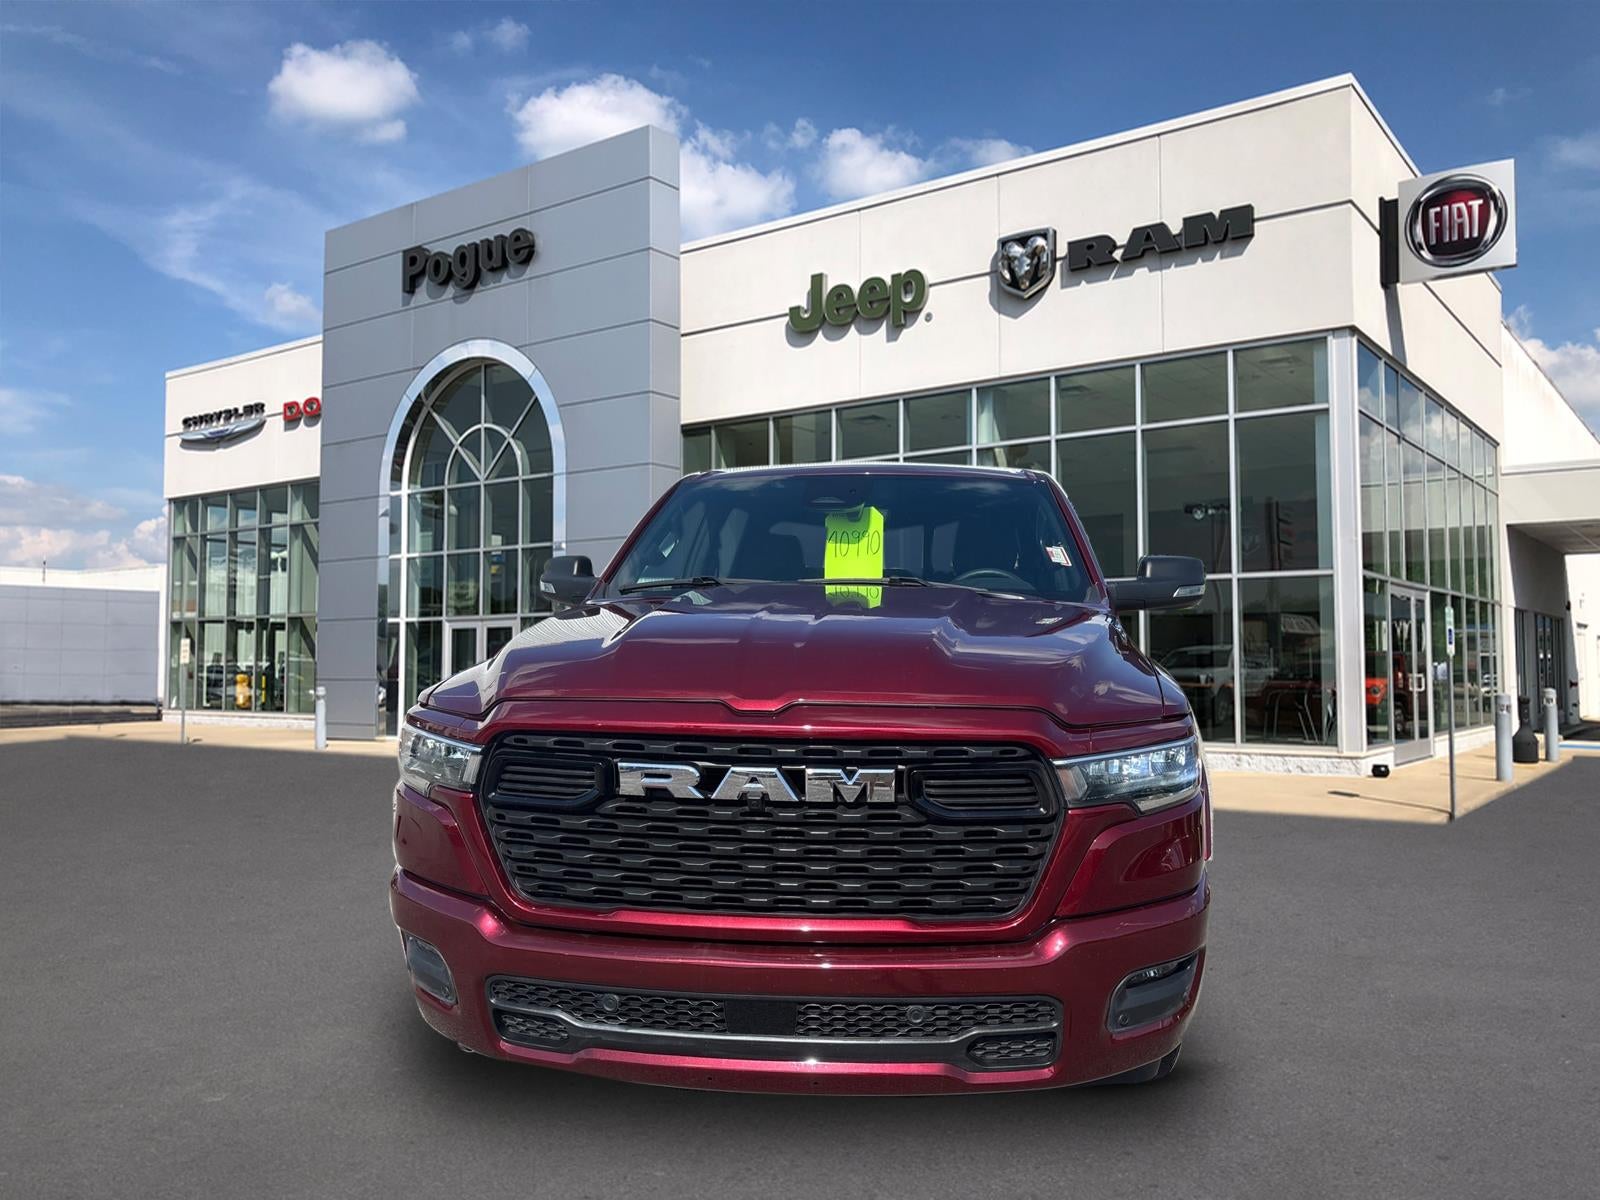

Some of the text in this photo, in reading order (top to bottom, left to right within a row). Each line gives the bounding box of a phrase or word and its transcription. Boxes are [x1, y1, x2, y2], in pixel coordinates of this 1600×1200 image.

[1067, 203, 1255, 272] RAM
[1428, 199, 1484, 246] FIAT
[402, 227, 536, 294] Pogue
[788, 268, 929, 333] Jeep
[616, 760, 896, 803] RAM
